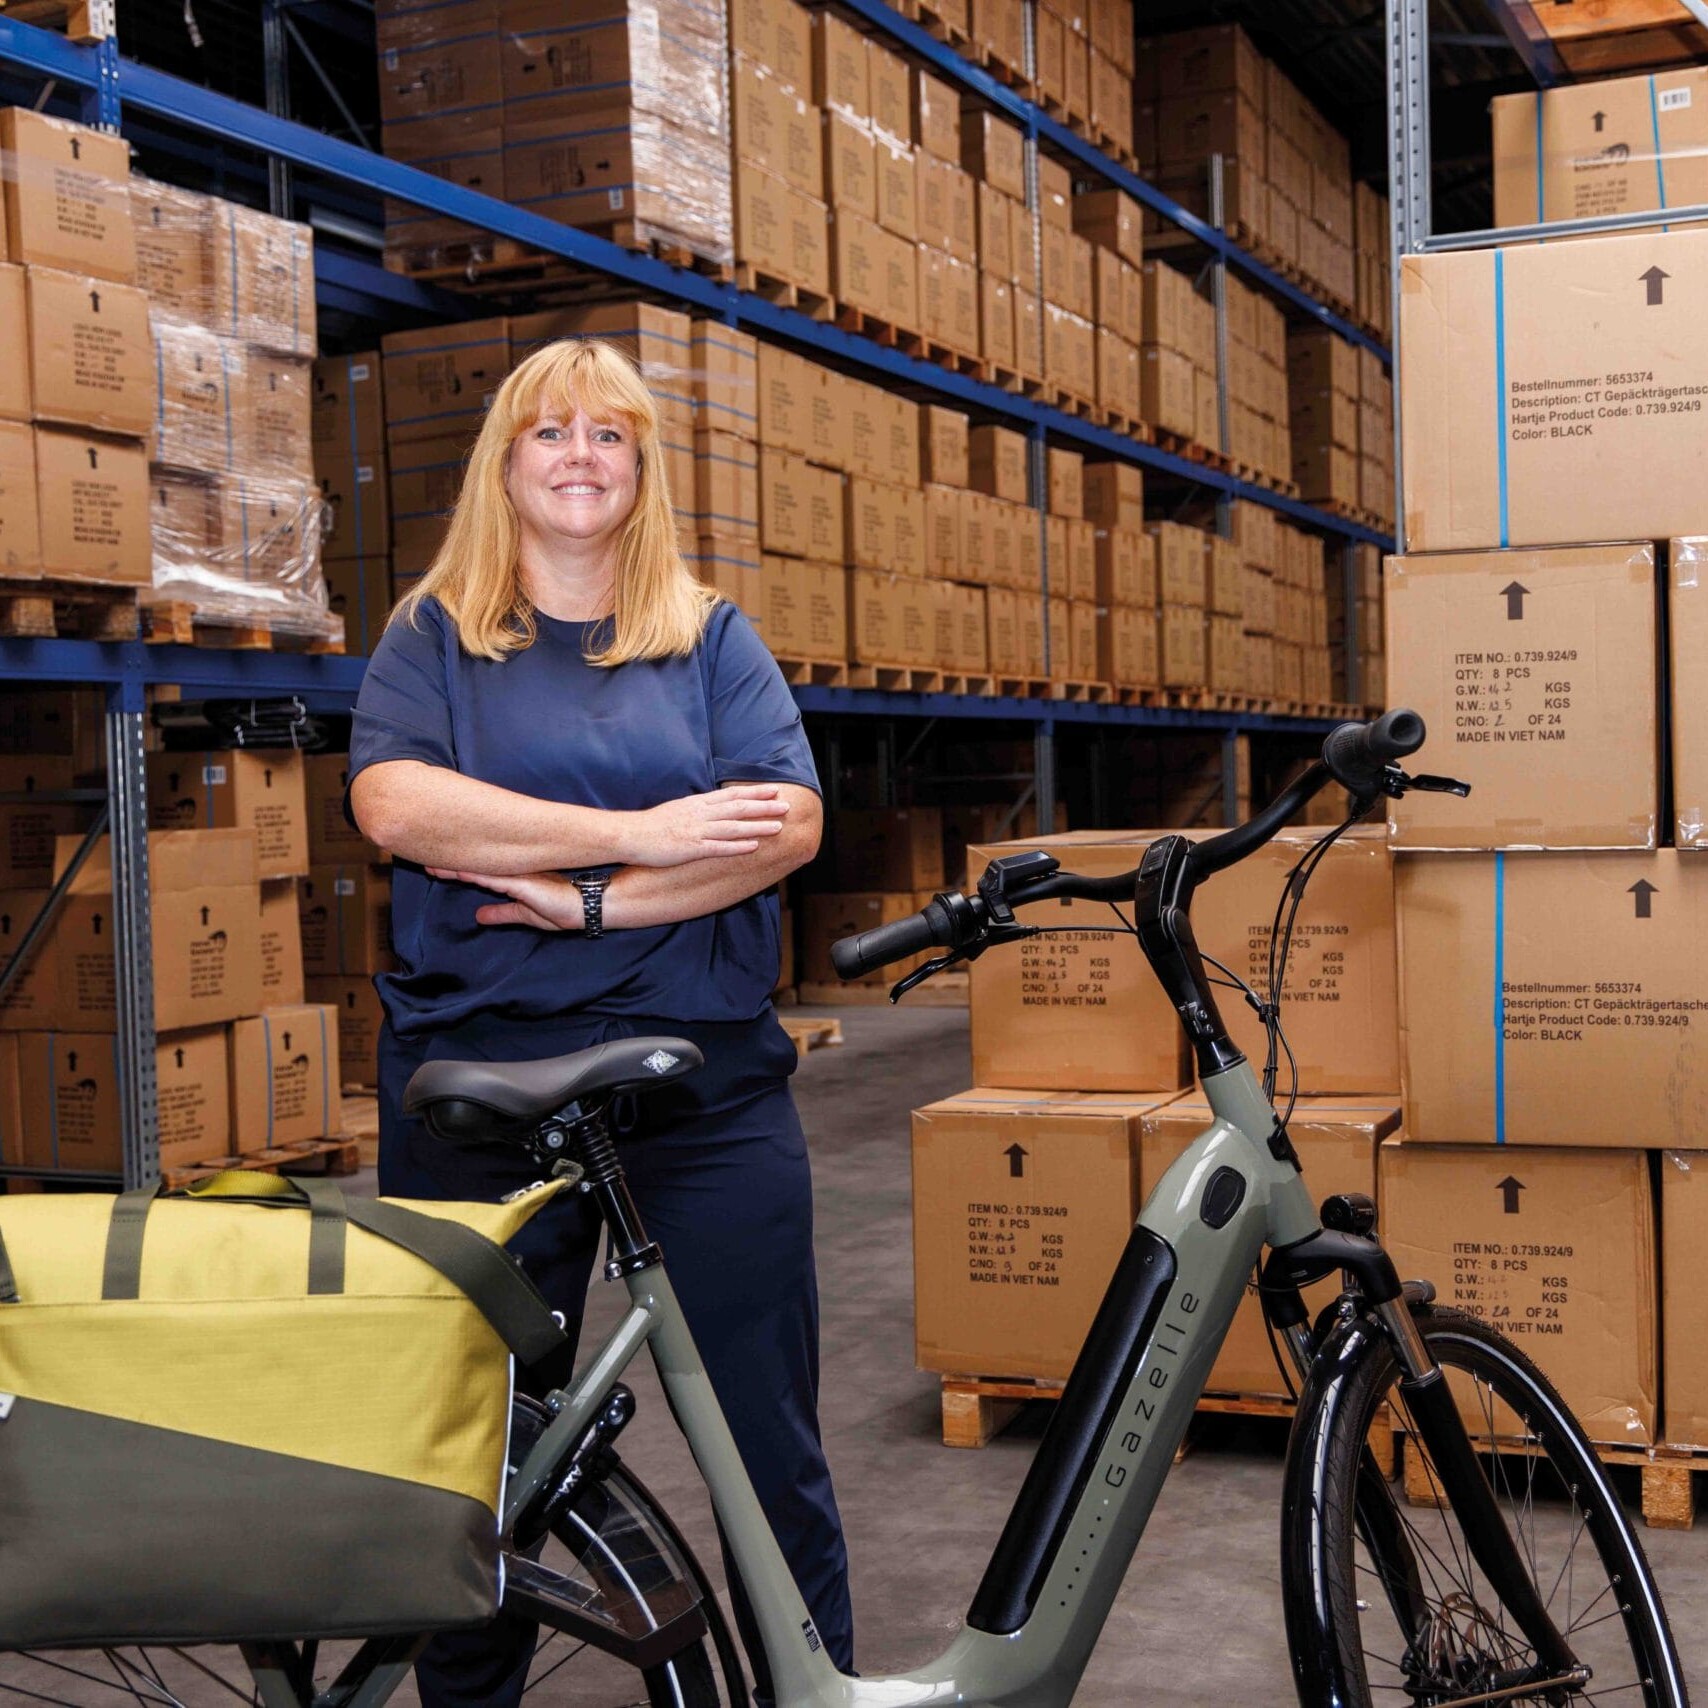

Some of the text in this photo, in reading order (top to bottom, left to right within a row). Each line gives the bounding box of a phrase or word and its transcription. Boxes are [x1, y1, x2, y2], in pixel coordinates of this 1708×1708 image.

[1512, 372, 1653, 392] Bestellnummer: 5653374
[1512, 395, 1581, 408] Description:
[1585, 392, 1600, 403] CT
[1512, 400, 1701, 426] Hartje Product Code: 0.739.924/9
[1512, 425, 1593, 441] Color: BLACK
[1455, 650, 1578, 664] ITEM NO.: 0.739.924/9
[1455, 667, 1531, 680] QTY: 8 PCS
[1455, 684, 1486, 695] G.W.:
[1545, 682, 1571, 693] KGS
[1456, 700, 1486, 711] N.W.:
[1544, 698, 1571, 709] KGS
[1456, 716, 1489, 727] C/NO:
[1528, 714, 1544, 725] OF
[1548, 714, 1561, 725] 24
[1456, 730, 1565, 742] MADE IN VIET NAM
[1248, 926, 1272, 935] ITEM
[1297, 926, 1349, 935] 0.739.924/9
[1066, 932, 1114, 942] 0.739.924/9
[1060, 945, 1079, 954] PCS
[1290, 939, 1310, 948] PCS
[1090, 958, 1110, 967] KGS
[1322, 952, 1344, 962] KGS
[1089, 971, 1110, 980] KGS
[1322, 966, 1344, 975] KGS
[1077, 984, 1089, 993] OF
[1093, 984, 1103, 993] 24
[1309, 979, 1322, 988] OF
[1325, 979, 1336, 988] 24
[1502, 982, 1642, 993] Bestellnummer: 5653374
[1022, 997, 1107, 1006] MADE IN VIET NAM
[1281, 992, 1291, 1001] IN
[1292, 992, 1315, 1001] VIET
[1318, 992, 1340, 1001] NAM
[1502, 997, 1570, 1011] Description:
[1574, 998, 1590, 1009] CT
[1539, 1014, 1584, 1025] Product
[1587, 1014, 1621, 1025] Code:
[1624, 1014, 1689, 1026] 0.739.924/9
[1503, 1029, 1582, 1041] Color: BLACK
[968, 1203, 991, 1213] ITEM
[1016, 1205, 1068, 1217] 0.739.924/9
[968, 1217, 992, 1228] QTY:
[1010, 1219, 1030, 1229] PCS
[1041, 1234, 1064, 1244] KGS
[1041, 1248, 1063, 1258] KGS
[1453, 1243, 1573, 1257] ITEM NO.: 0.739.924/9
[1029, 1261, 1041, 1271] OF
[1045, 1262, 1056, 1272] 24
[1454, 1258, 1528, 1271] QTY: 8 PCS
[970, 1272, 1060, 1286] MADE IN VIET NAM
[1454, 1274, 1484, 1285] G.W.:
[1542, 1277, 1568, 1288] KGS
[1455, 1289, 1484, 1300] N.W.:
[1542, 1293, 1568, 1304] KGS
[1526, 1307, 1541, 1318] OF
[1546, 1308, 1559, 1319] 24
[1507, 1322, 1533, 1333] VIET
[1536, 1323, 1563, 1334] NAM
[1105, 1292, 1200, 1488] Gazelle
